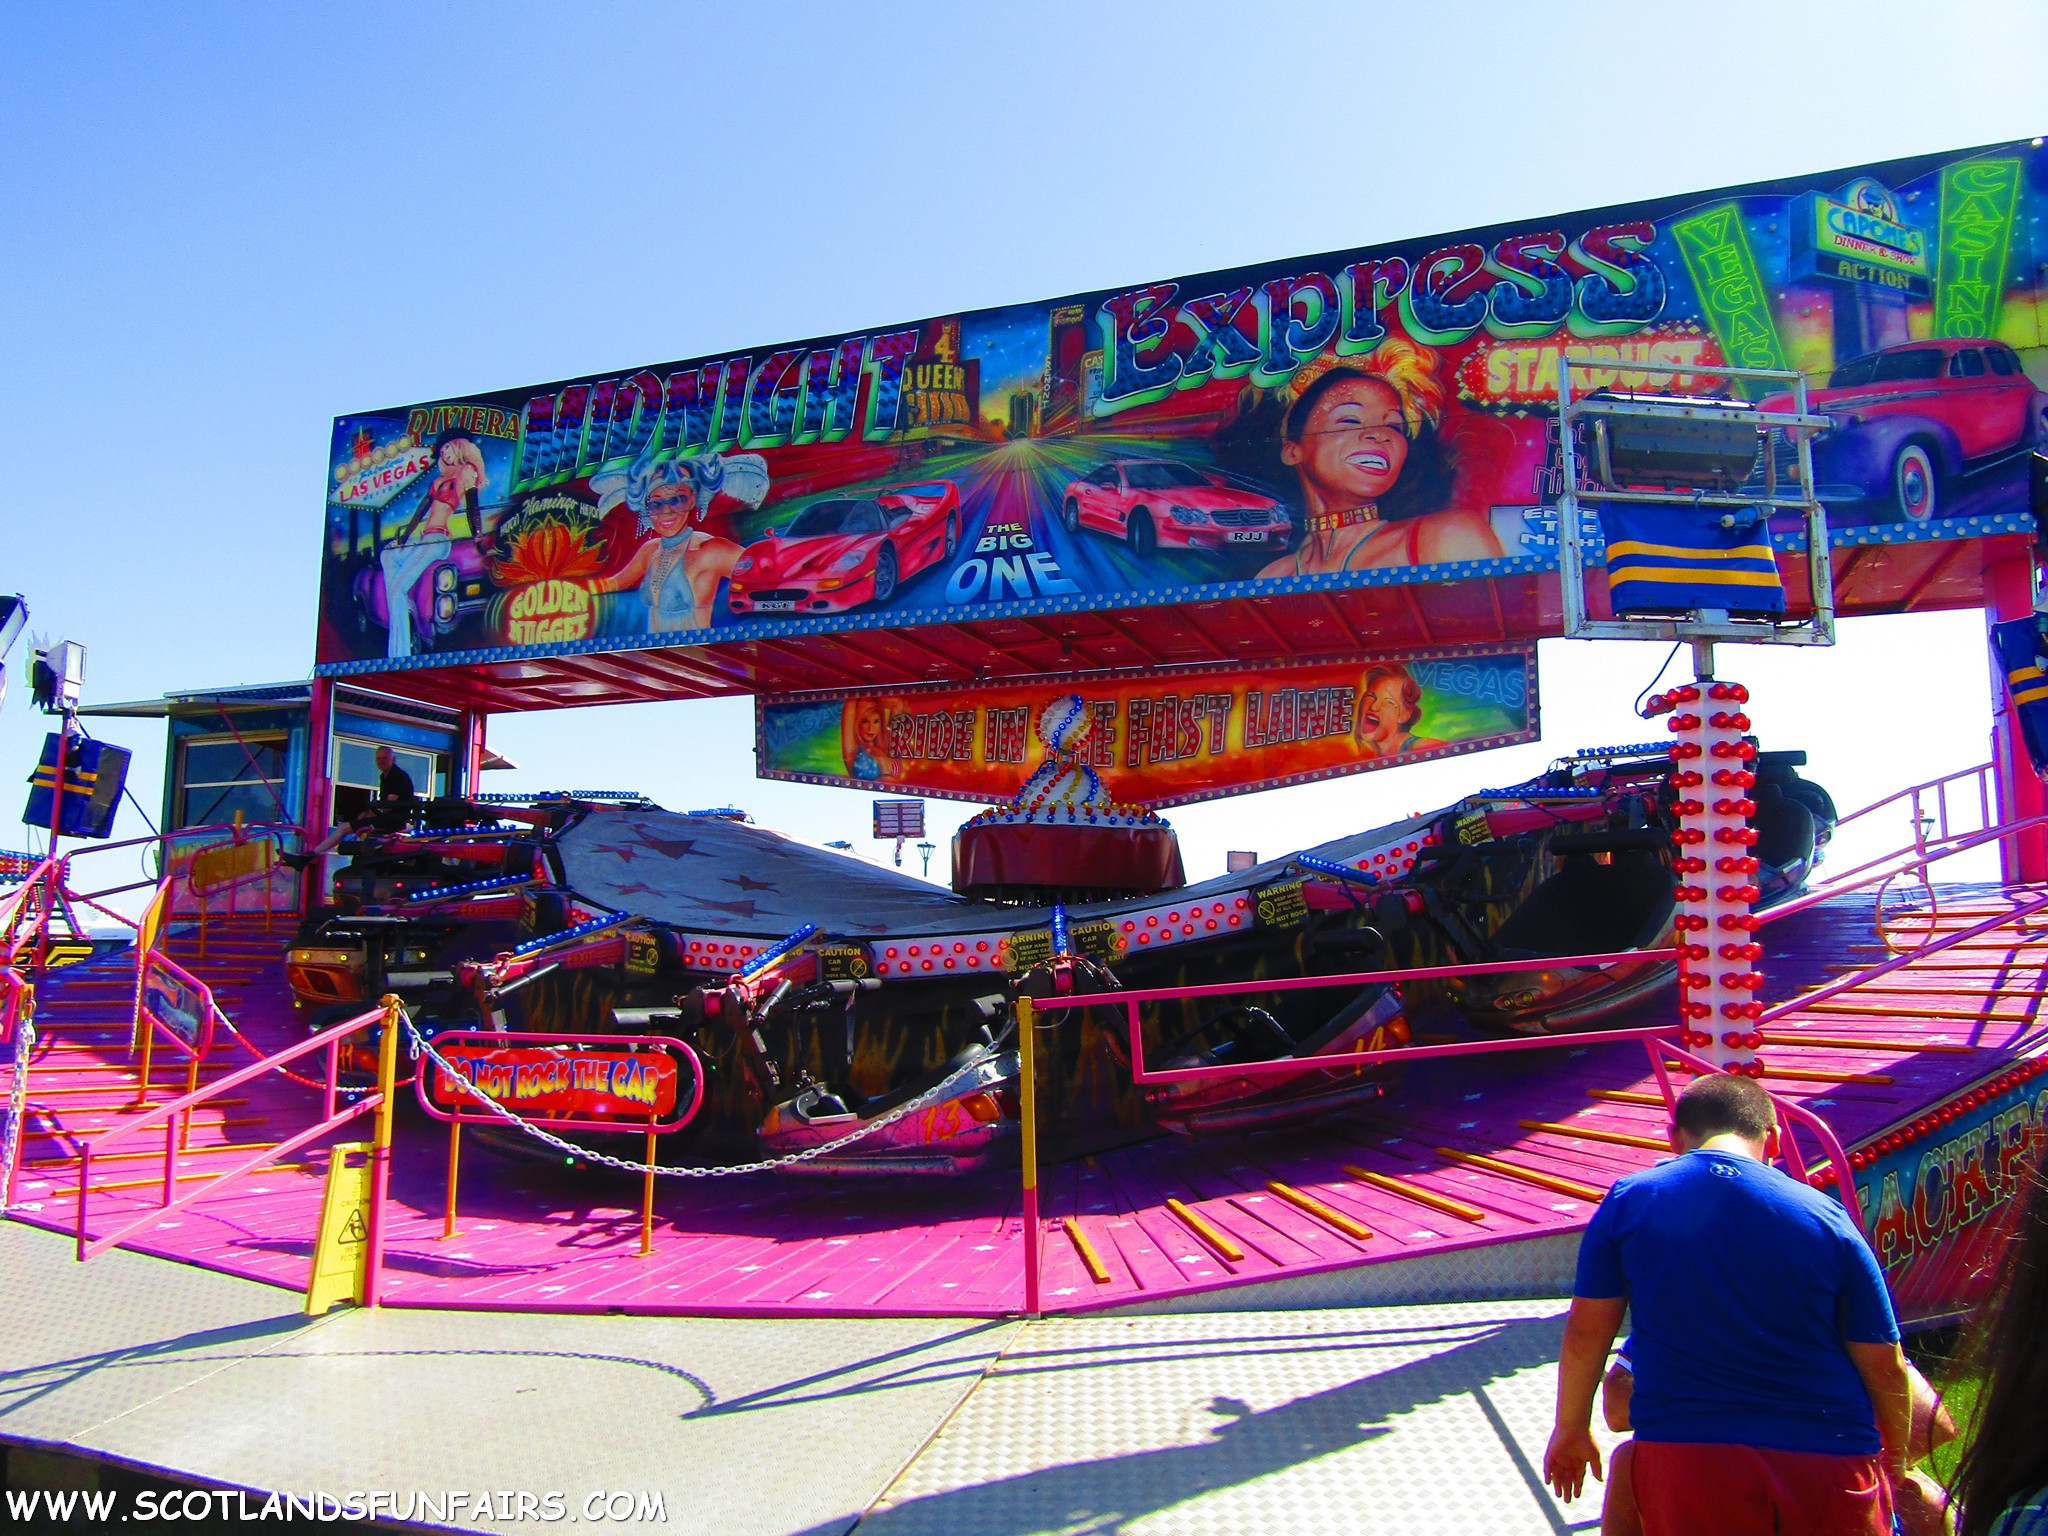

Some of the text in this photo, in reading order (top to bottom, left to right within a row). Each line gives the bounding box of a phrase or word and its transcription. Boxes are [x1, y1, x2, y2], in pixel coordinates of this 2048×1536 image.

[1943, 164, 2008, 339] CASINO
[1681, 211, 1776, 371] VEGAS
[1838, 260, 1911, 289] ACTION
[1487, 340, 1702, 394] STARDUST
[406, 405, 521, 446] RIVIERA
[340, 455, 430, 502] LAS VEGAS
[522, 492, 579, 515] Flamingo
[975, 533, 1034, 553] BIG
[986, 522, 1023, 534] THE
[1234, 532, 1263, 541] RJJ
[944, 551, 1084, 606] ONE
[510, 579, 590, 619] GOLDEN
[509, 613, 590, 645] NUGGET
[1411, 660, 1526, 710] VEGAS
[888, 709, 976, 761] RIDE
[984, 706, 1029, 763] IN
[1127, 693, 1232, 767] FAST
[1244, 685, 1356, 750] LANE
[1257, 880, 1303, 899] WARNING
[1276, 914, 1290, 923] NOT
[818, 948, 861, 957] CAUTION
[1082, 935, 1097, 943] CAR
[444, 1056, 659, 1107] DO NOT ROCK THE CAR
[922, 1098, 961, 1145] 13
